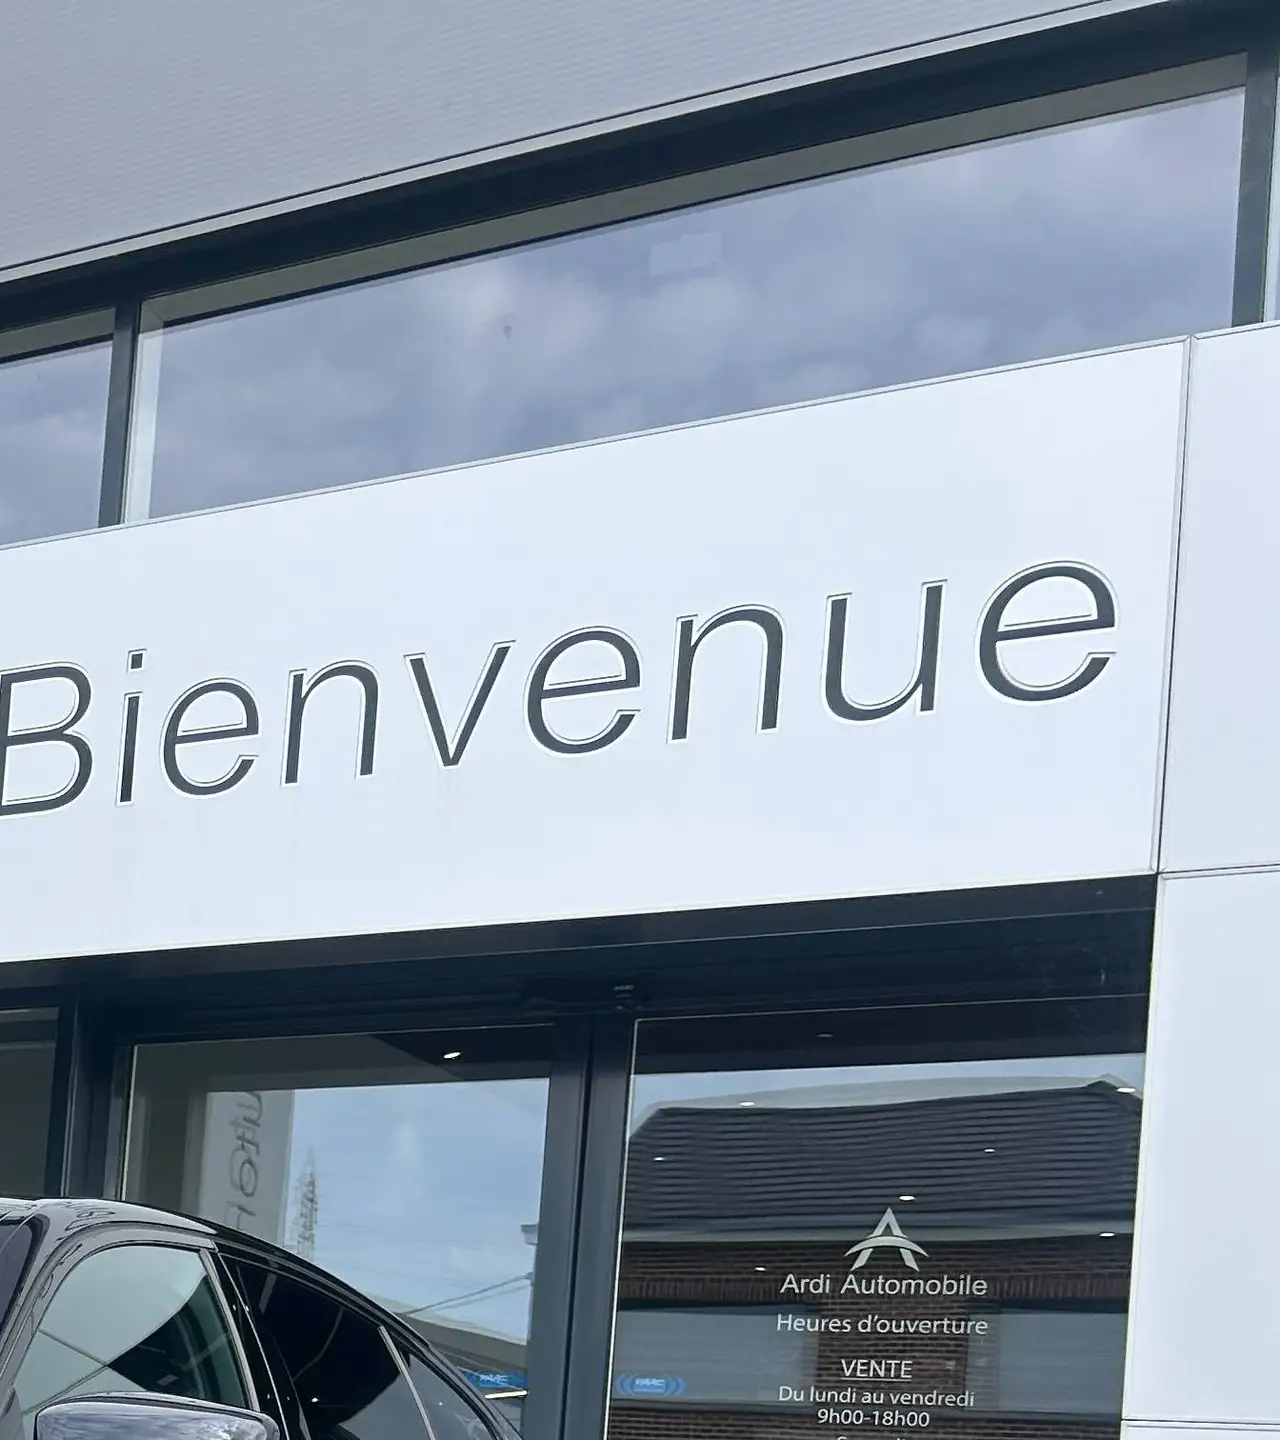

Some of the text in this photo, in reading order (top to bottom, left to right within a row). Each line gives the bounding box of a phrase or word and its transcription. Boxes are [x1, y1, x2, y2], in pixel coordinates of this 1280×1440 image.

[779, 1273, 989, 1296] Ardi Automobile
[776, 1313, 852, 1334] Heures
[840, 1359, 913, 1378] VENTE
[778, 1385, 975, 1407] Du lundi au vendredi
[816, 1408, 930, 1427] 9h00-18h00
